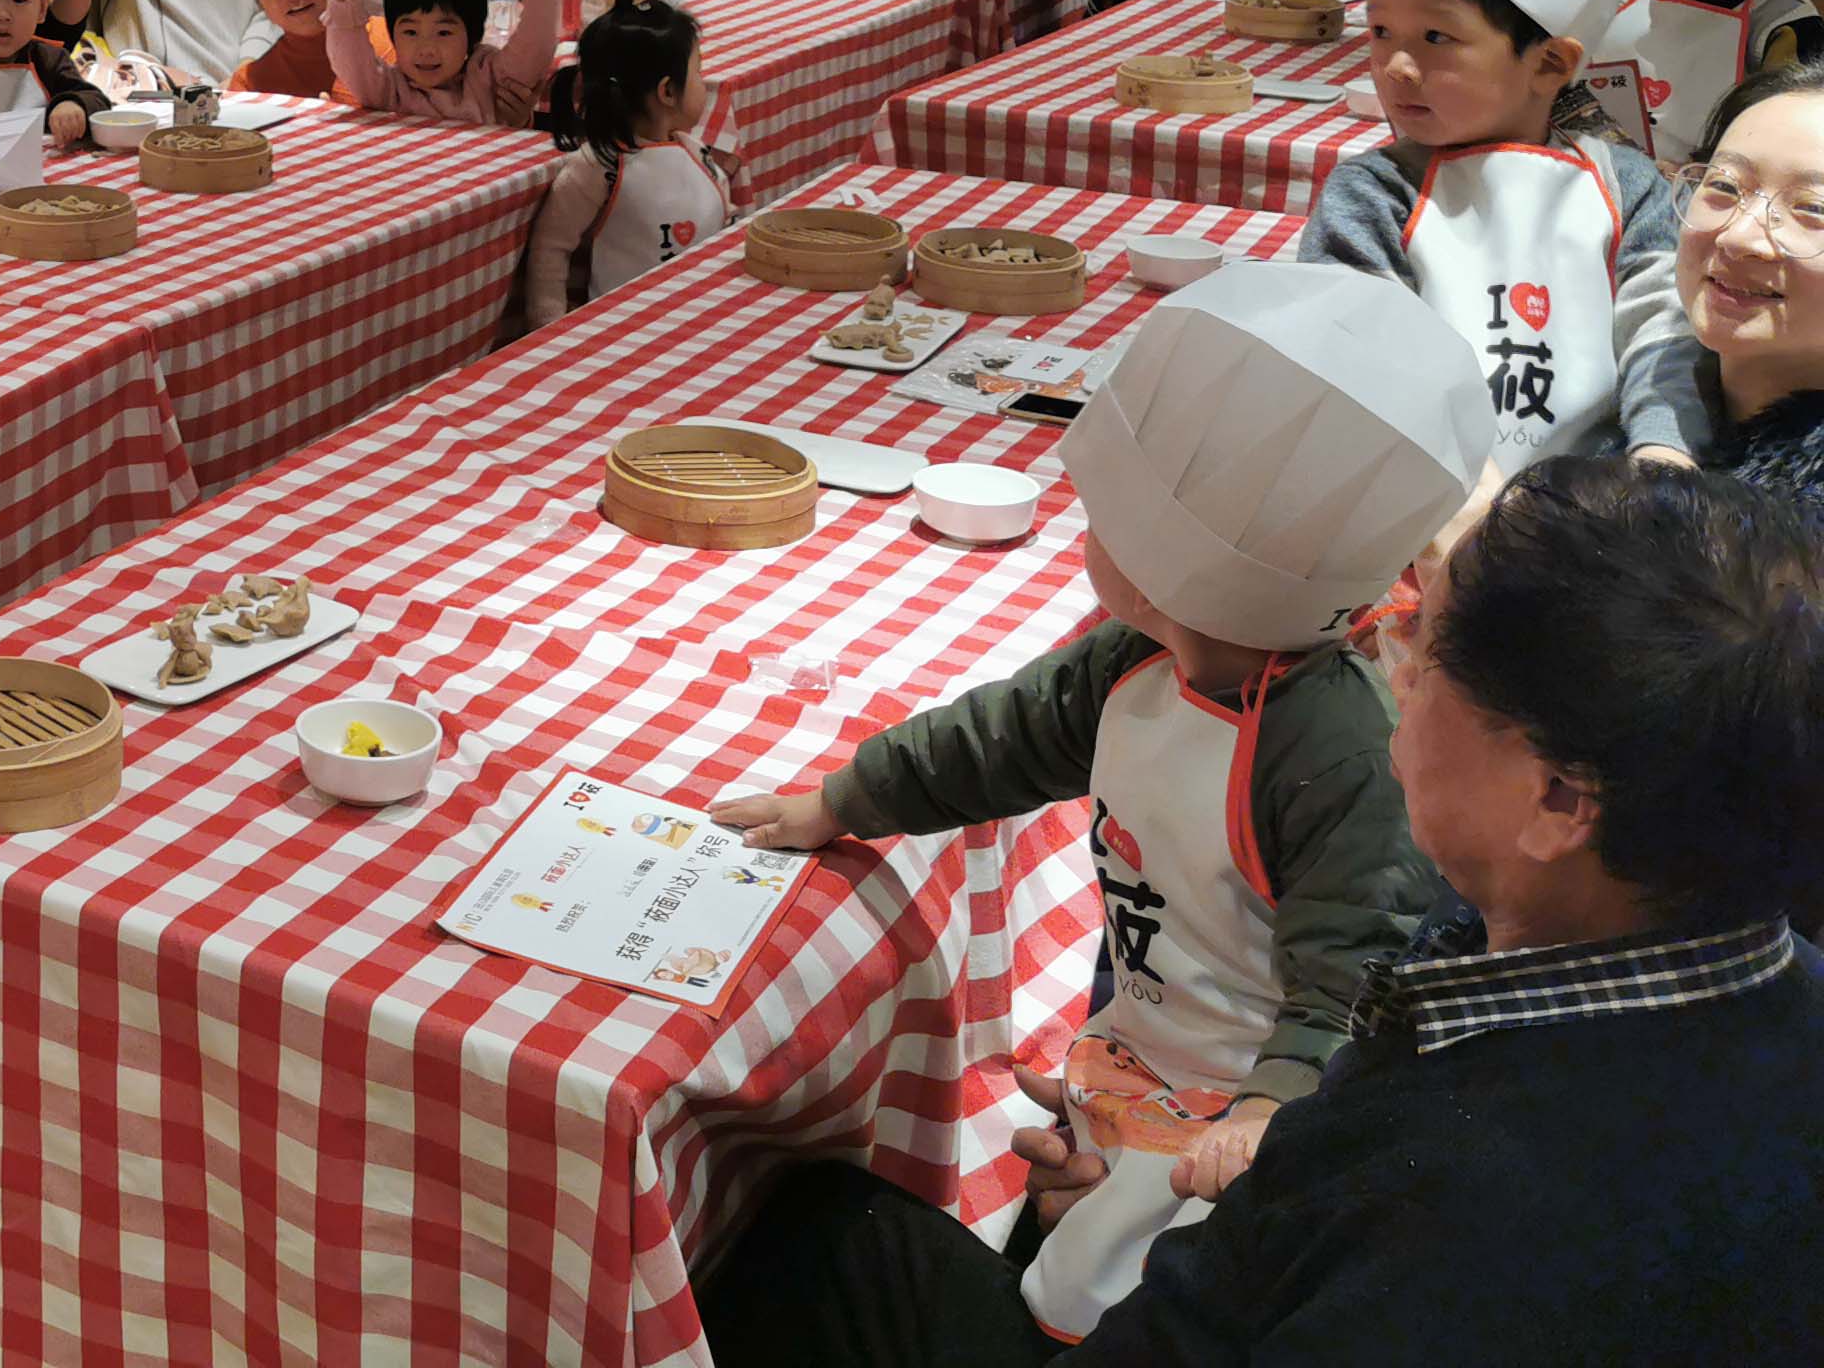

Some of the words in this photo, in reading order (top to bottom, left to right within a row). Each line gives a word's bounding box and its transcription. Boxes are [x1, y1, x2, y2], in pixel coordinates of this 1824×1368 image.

[659, 223, 673, 249] I
[1487, 284, 1508, 329] I
[1486, 337, 1555, 424] 莜
[1319, 608, 1353, 631] I
[540, 845, 587, 884] 莜面小达人
